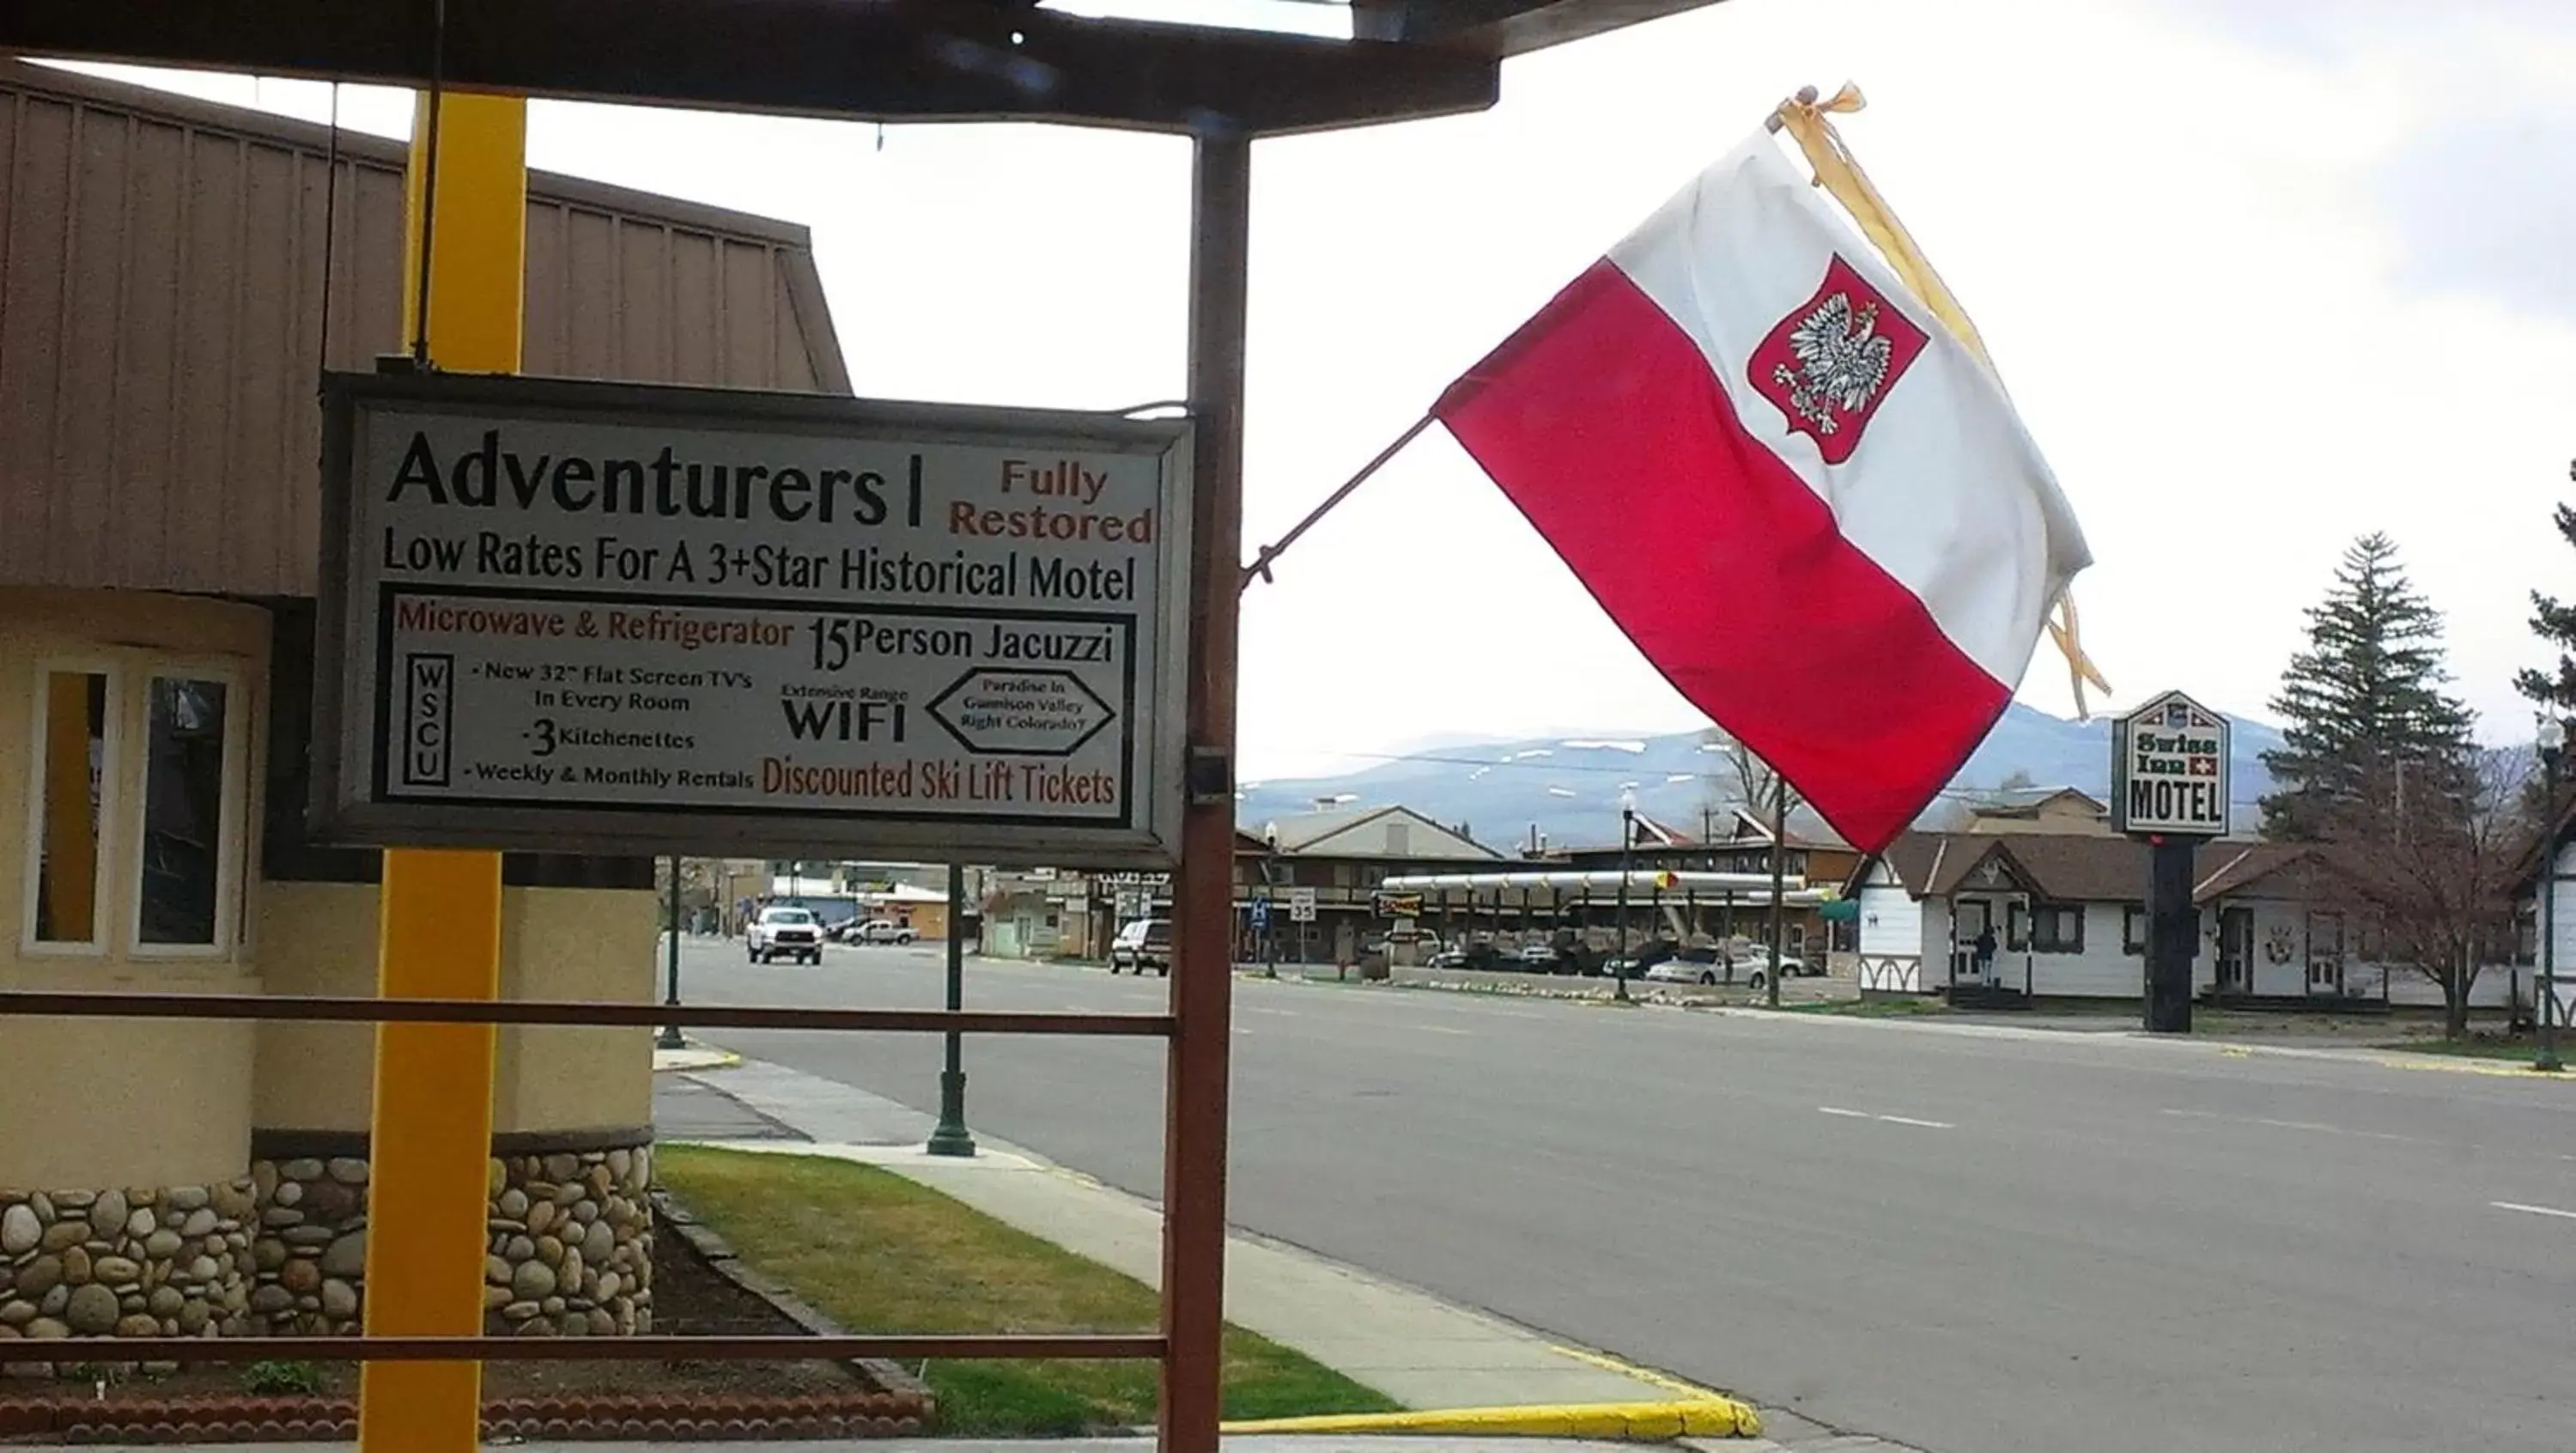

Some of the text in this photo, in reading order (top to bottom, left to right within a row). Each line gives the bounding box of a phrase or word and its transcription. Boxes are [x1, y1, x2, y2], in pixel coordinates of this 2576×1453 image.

[385, 429, 886, 526] Adventurers
[1001, 459, 1108, 505] Fully
[949, 499, 1151, 543] Restored
[384, 526, 1135, 601] Low Rates For A 3+Star Historical Motel
[398, 599, 795, 651] Microwave & Refrigerator
[983, 621, 1115, 663] Jacuzzi
[485, 661, 535, 679] New
[583, 666, 623, 684] Flat
[629, 667, 703, 687] Screen
[708, 671, 752, 689] TV's
[982, 678, 1066, 693] Paradise In
[535, 690, 690, 713] In Every Room
[858, 686, 908, 705] Range
[963, 696, 1084, 715] Gunnison Valley
[559, 727, 695, 749] Kitchenettes
[781, 700, 905, 743] WIFI
[2136, 733, 2218, 754] Swiss
[475, 762, 754, 788] Weekly & Monthly Rentals
[762, 755, 1115, 805] Discounted Ski Lift Tickets
[2136, 754, 2186, 775] Inn
[2129, 779, 2223, 823] MOTEL
